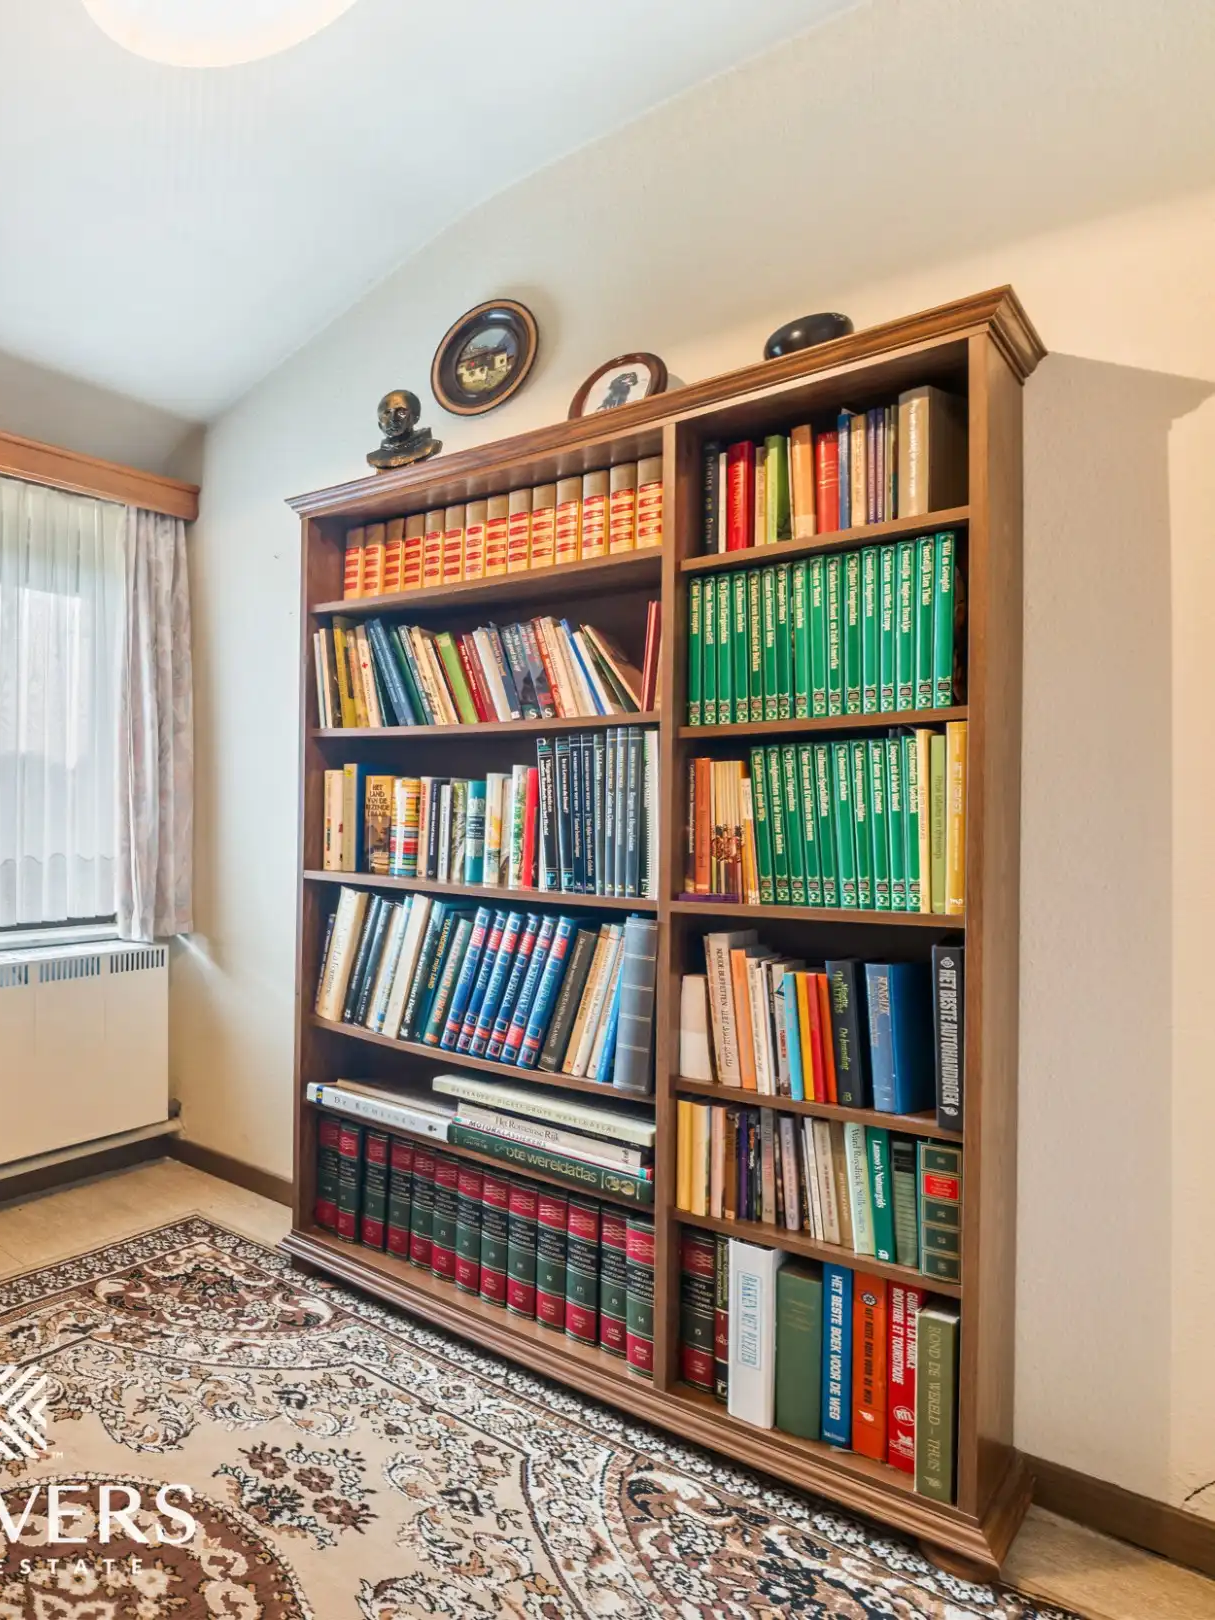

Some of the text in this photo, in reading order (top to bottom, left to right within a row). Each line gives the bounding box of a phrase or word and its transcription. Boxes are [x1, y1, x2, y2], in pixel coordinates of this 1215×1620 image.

[428, 919, 450, 989] VLAANDEREN mijn LAND
[503, 967, 520, 1008] AFRIKA
[718, 970, 727, 1006] BUFFETTEN
[841, 984, 849, 1007] Minette
[940, 969, 960, 1105] HET BESTE AUTOHANDBOEK
[495, 1116, 560, 1142] Het Romeinse Rijk
[527, 1154, 597, 1184] wereldatlas
[872, 1139, 886, 1209] Lannoo's Natuurgids
[742, 1275, 757, 1365] BAKKEN MET PLEZIER
[892, 1288, 904, 1385] ROUTIERE ET TOURISTIQUE
[907, 1292, 918, 1369] GUIDE DE LA FRANCE
[829, 1275, 842, 1420] HET BESTE BOEK VOOR DE WEG
[928, 1325, 941, 1359] ROND
[928, 1362, 941, 1377] DE
[928, 1382, 941, 1425] WERELD
[927, 1439, 941, 1472] THUIS
